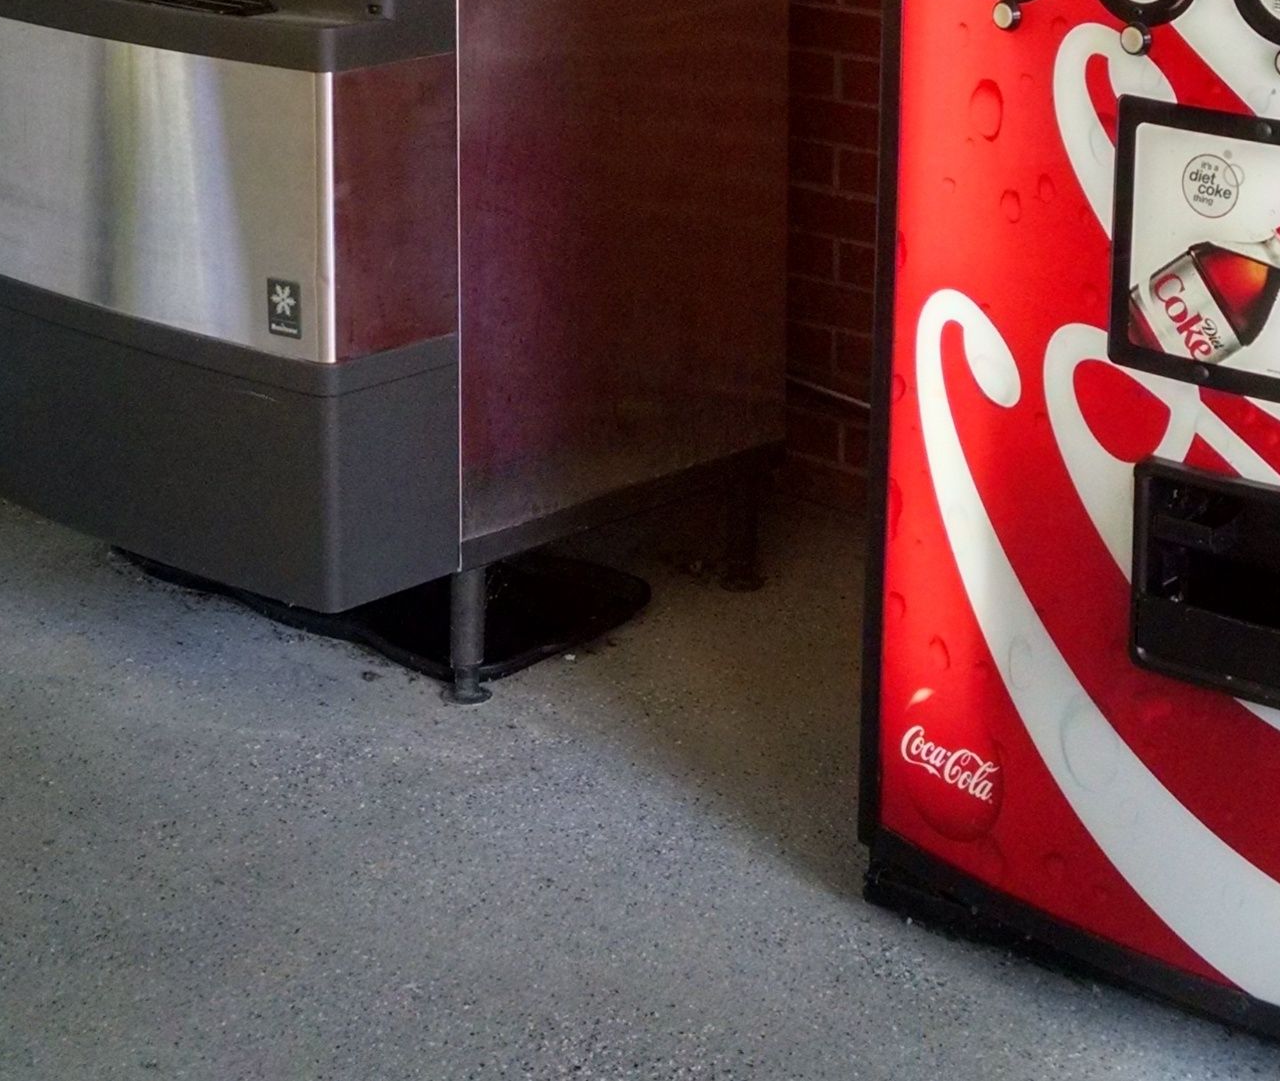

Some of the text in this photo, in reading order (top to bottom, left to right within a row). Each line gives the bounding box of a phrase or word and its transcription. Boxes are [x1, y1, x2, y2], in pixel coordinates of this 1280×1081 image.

[1189, 169, 1216, 185] diet
[1193, 194, 1214, 206] thing
[1198, 184, 1232, 199] coke
[1154, 273, 1212, 359] Coke
[1202, 318, 1225, 350] Diet
[901, 725, 1000, 801] Coca-Cola
